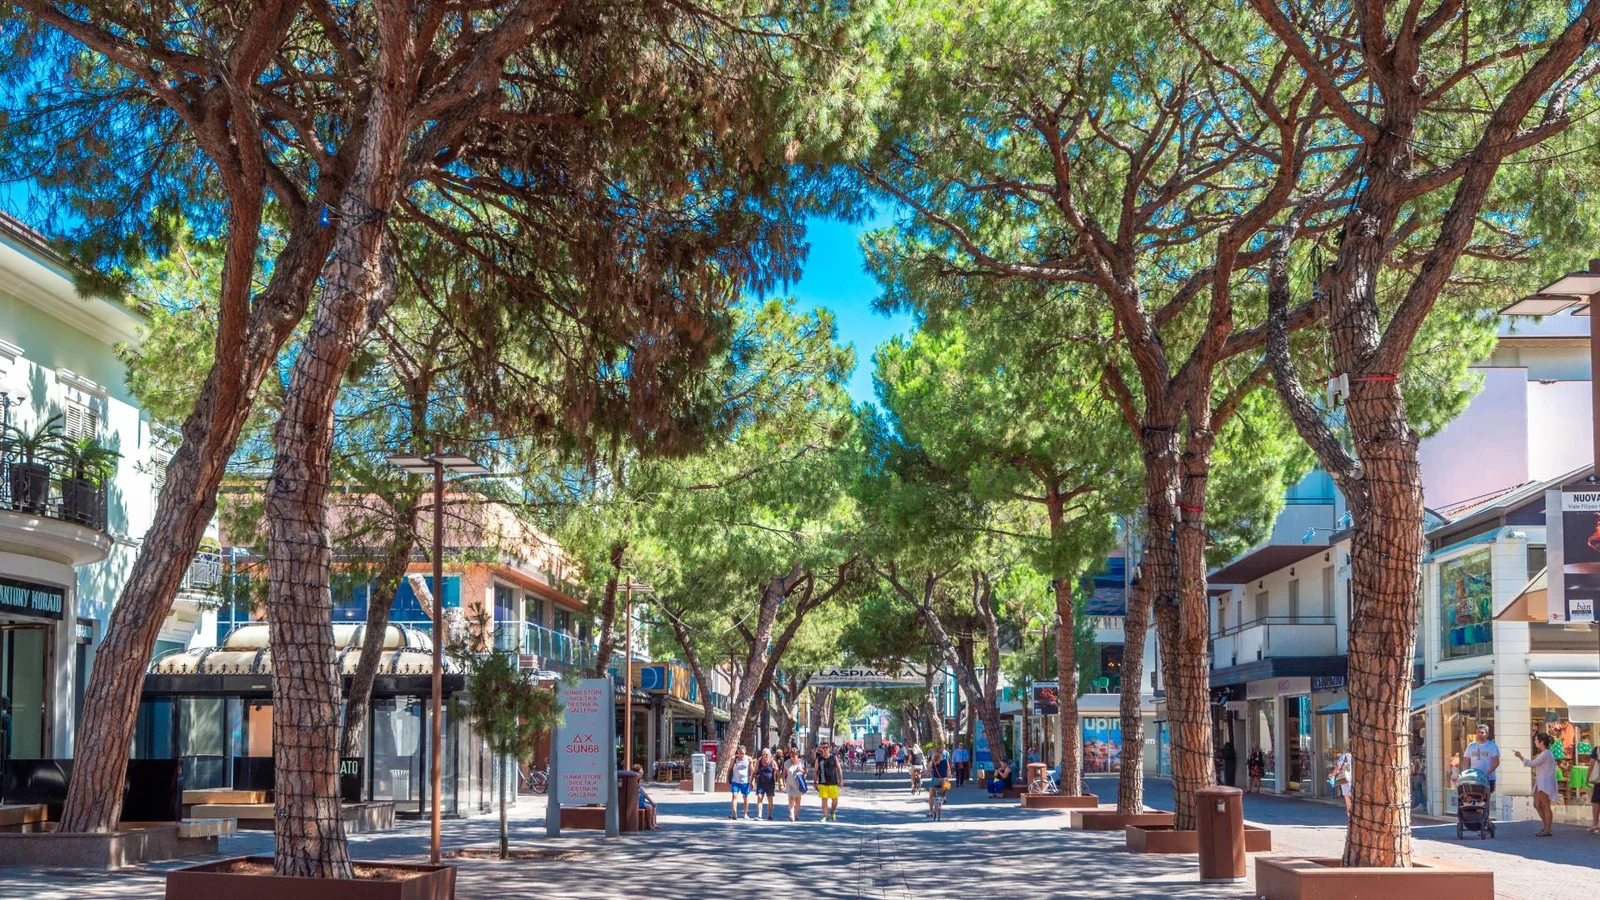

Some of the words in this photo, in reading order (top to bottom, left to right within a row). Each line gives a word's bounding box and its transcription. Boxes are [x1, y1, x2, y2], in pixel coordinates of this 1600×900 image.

[31, 590, 62, 613] MORATO
[566, 744, 600, 754] SUN68
[340, 760, 358, 775] ATO
